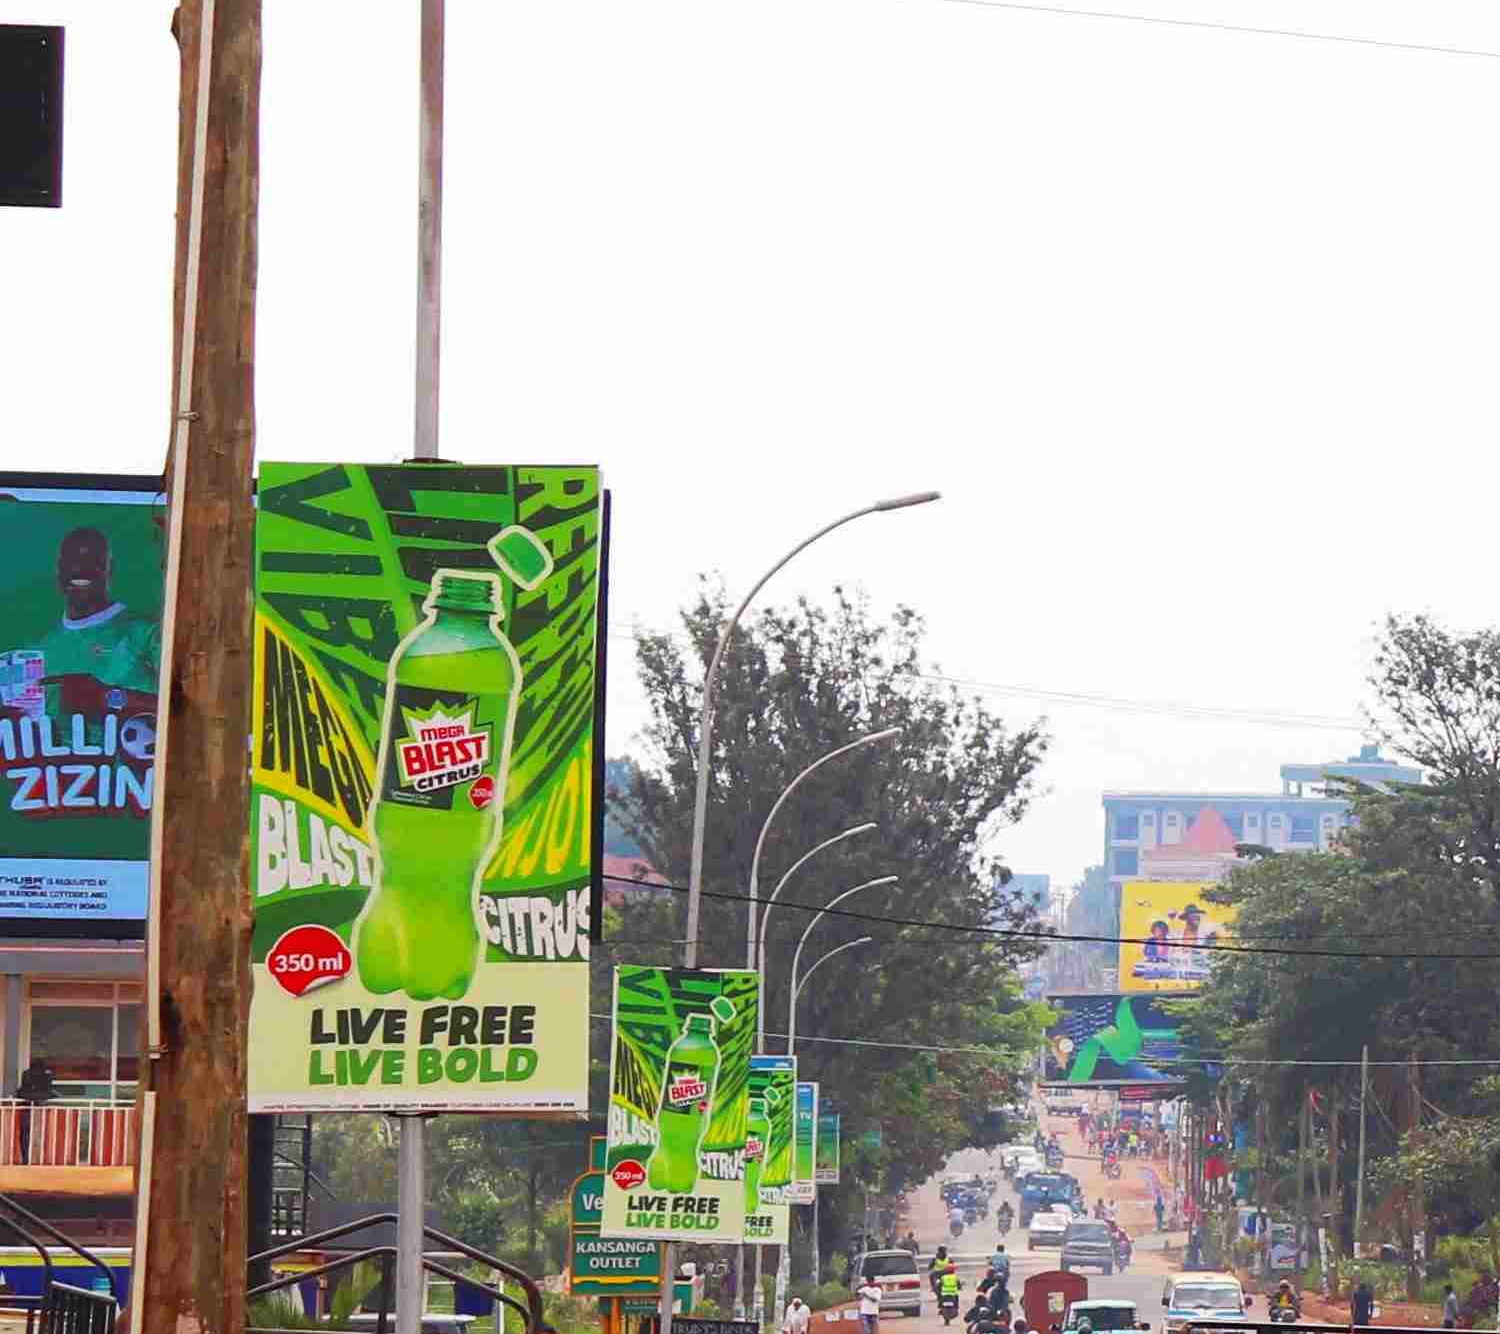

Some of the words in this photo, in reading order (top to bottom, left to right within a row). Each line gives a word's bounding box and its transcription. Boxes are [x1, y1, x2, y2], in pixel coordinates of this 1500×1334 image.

[403, 735, 486, 777] BLAST
[416, 764, 481, 789] CITRUS
[258, 793, 380, 896] BLAST
[478, 885, 594, 959] CITRUS
[274, 953, 317, 973] 350
[319, 950, 344, 971] ml
[310, 1007, 406, 1045] LIVE
[419, 1004, 537, 1044] FREE
[308, 1049, 405, 1086] LIVE
[417, 1047, 538, 1086] BOLD
[628, 1195, 667, 1212] LIVE
[672, 1197, 720, 1214] FREE
[626, 1213, 666, 1228] LIVE
[670, 1214, 719, 1230] BOLD
[576, 1242, 656, 1255] KANSANGA
[589, 1257, 641, 1269] OUTLET
